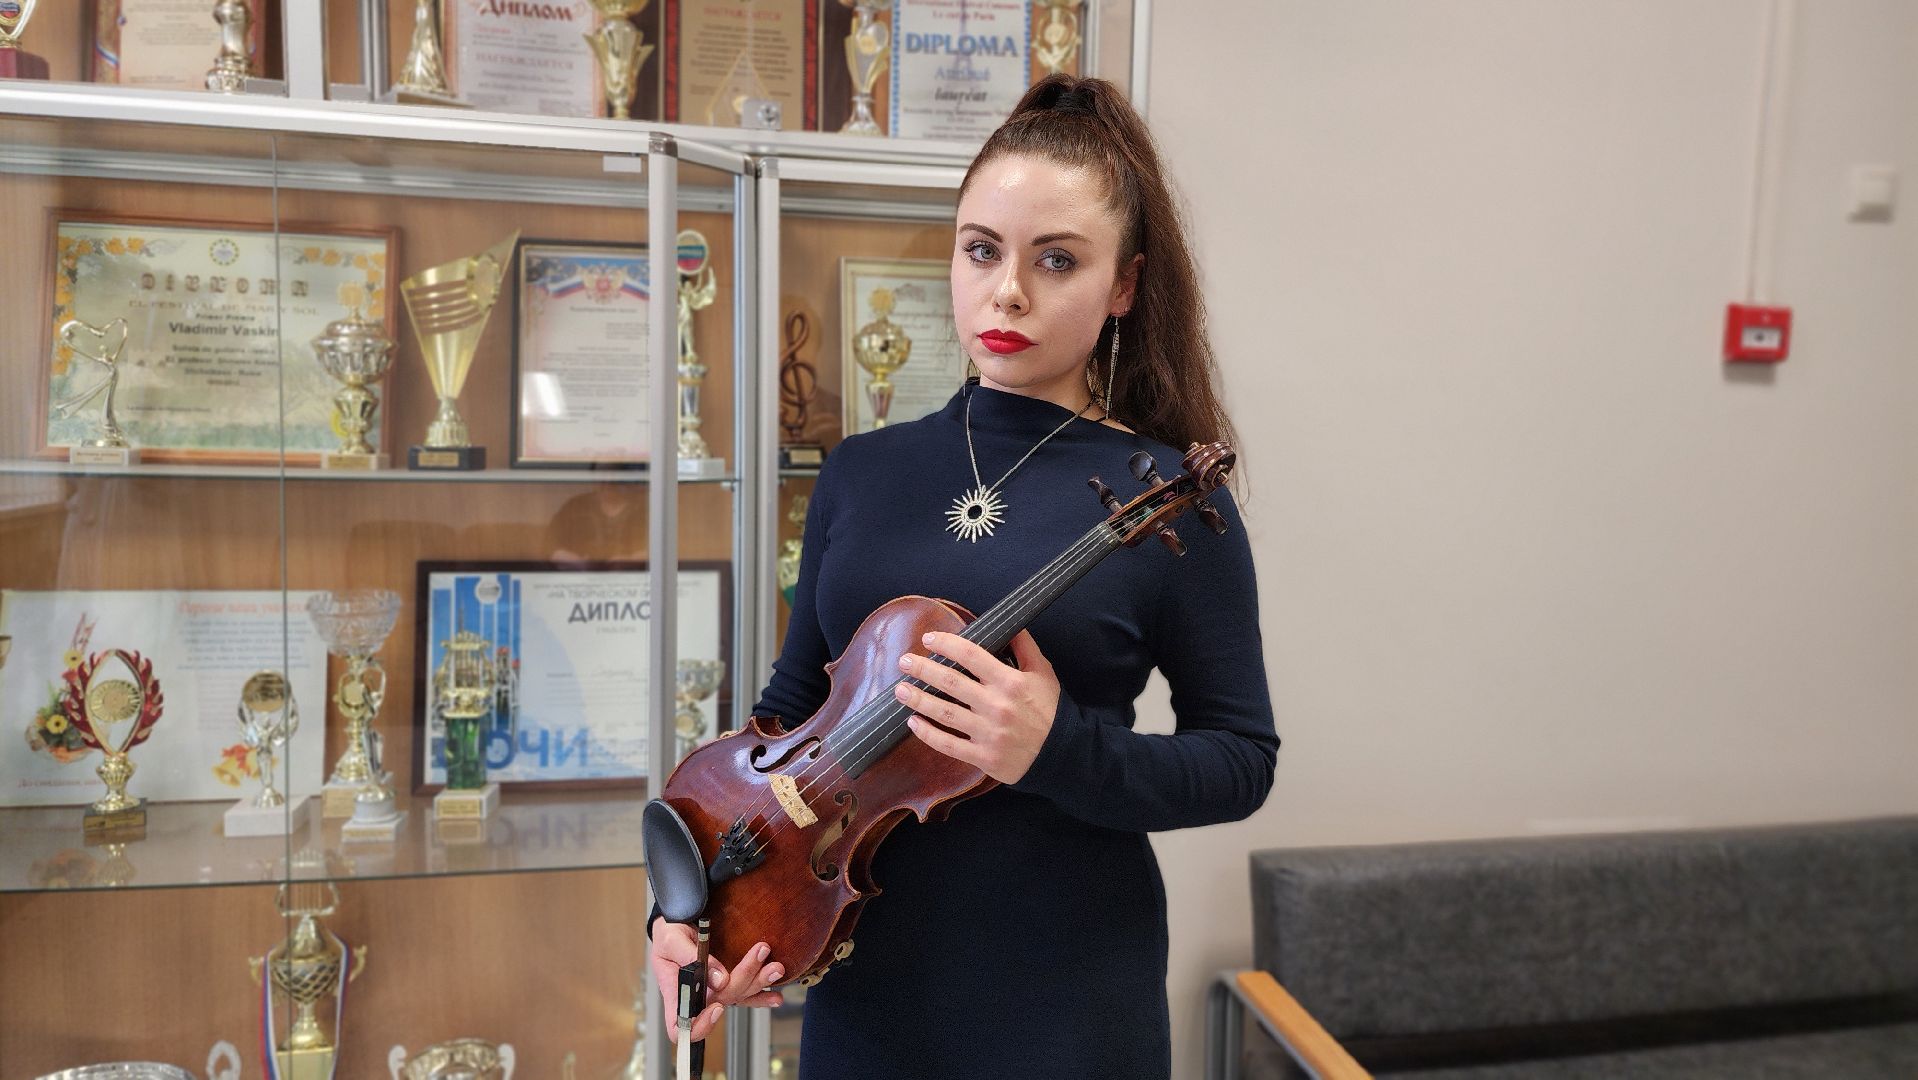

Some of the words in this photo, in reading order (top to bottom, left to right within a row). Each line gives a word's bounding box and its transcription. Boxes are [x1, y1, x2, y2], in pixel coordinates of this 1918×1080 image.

[480, 0, 573, 21] Диплом
[905, 31, 1019, 58] DIPLOMA
[169, 321, 228, 336] Vladimir
[233, 325, 280, 337] Vaskin
